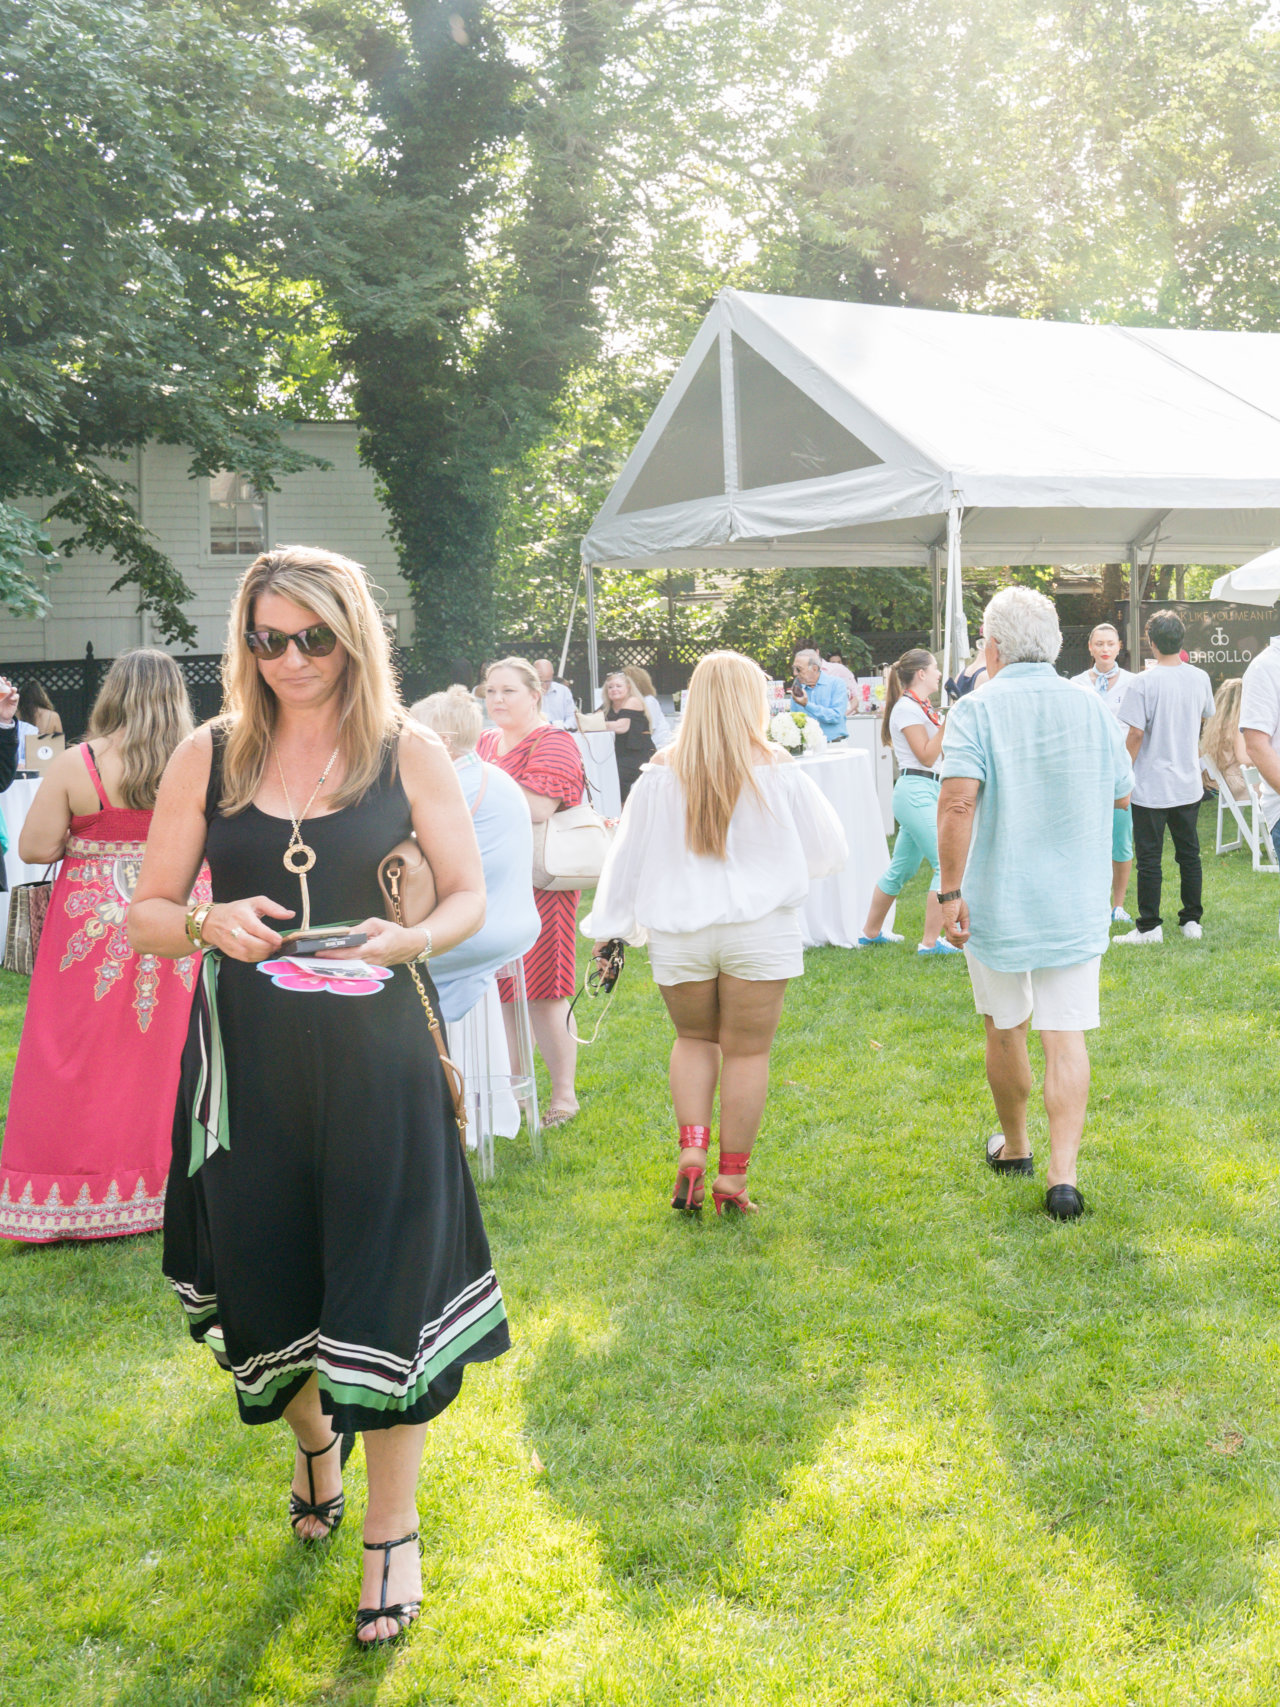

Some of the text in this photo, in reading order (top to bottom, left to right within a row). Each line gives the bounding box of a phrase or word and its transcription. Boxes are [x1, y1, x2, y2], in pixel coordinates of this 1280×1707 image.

[1211, 611, 1233, 620] YOU
[1236, 611, 1264, 620] MEAN
[1265, 610, 1273, 620] IT
[1189, 650, 1252, 664] BAROLLO
